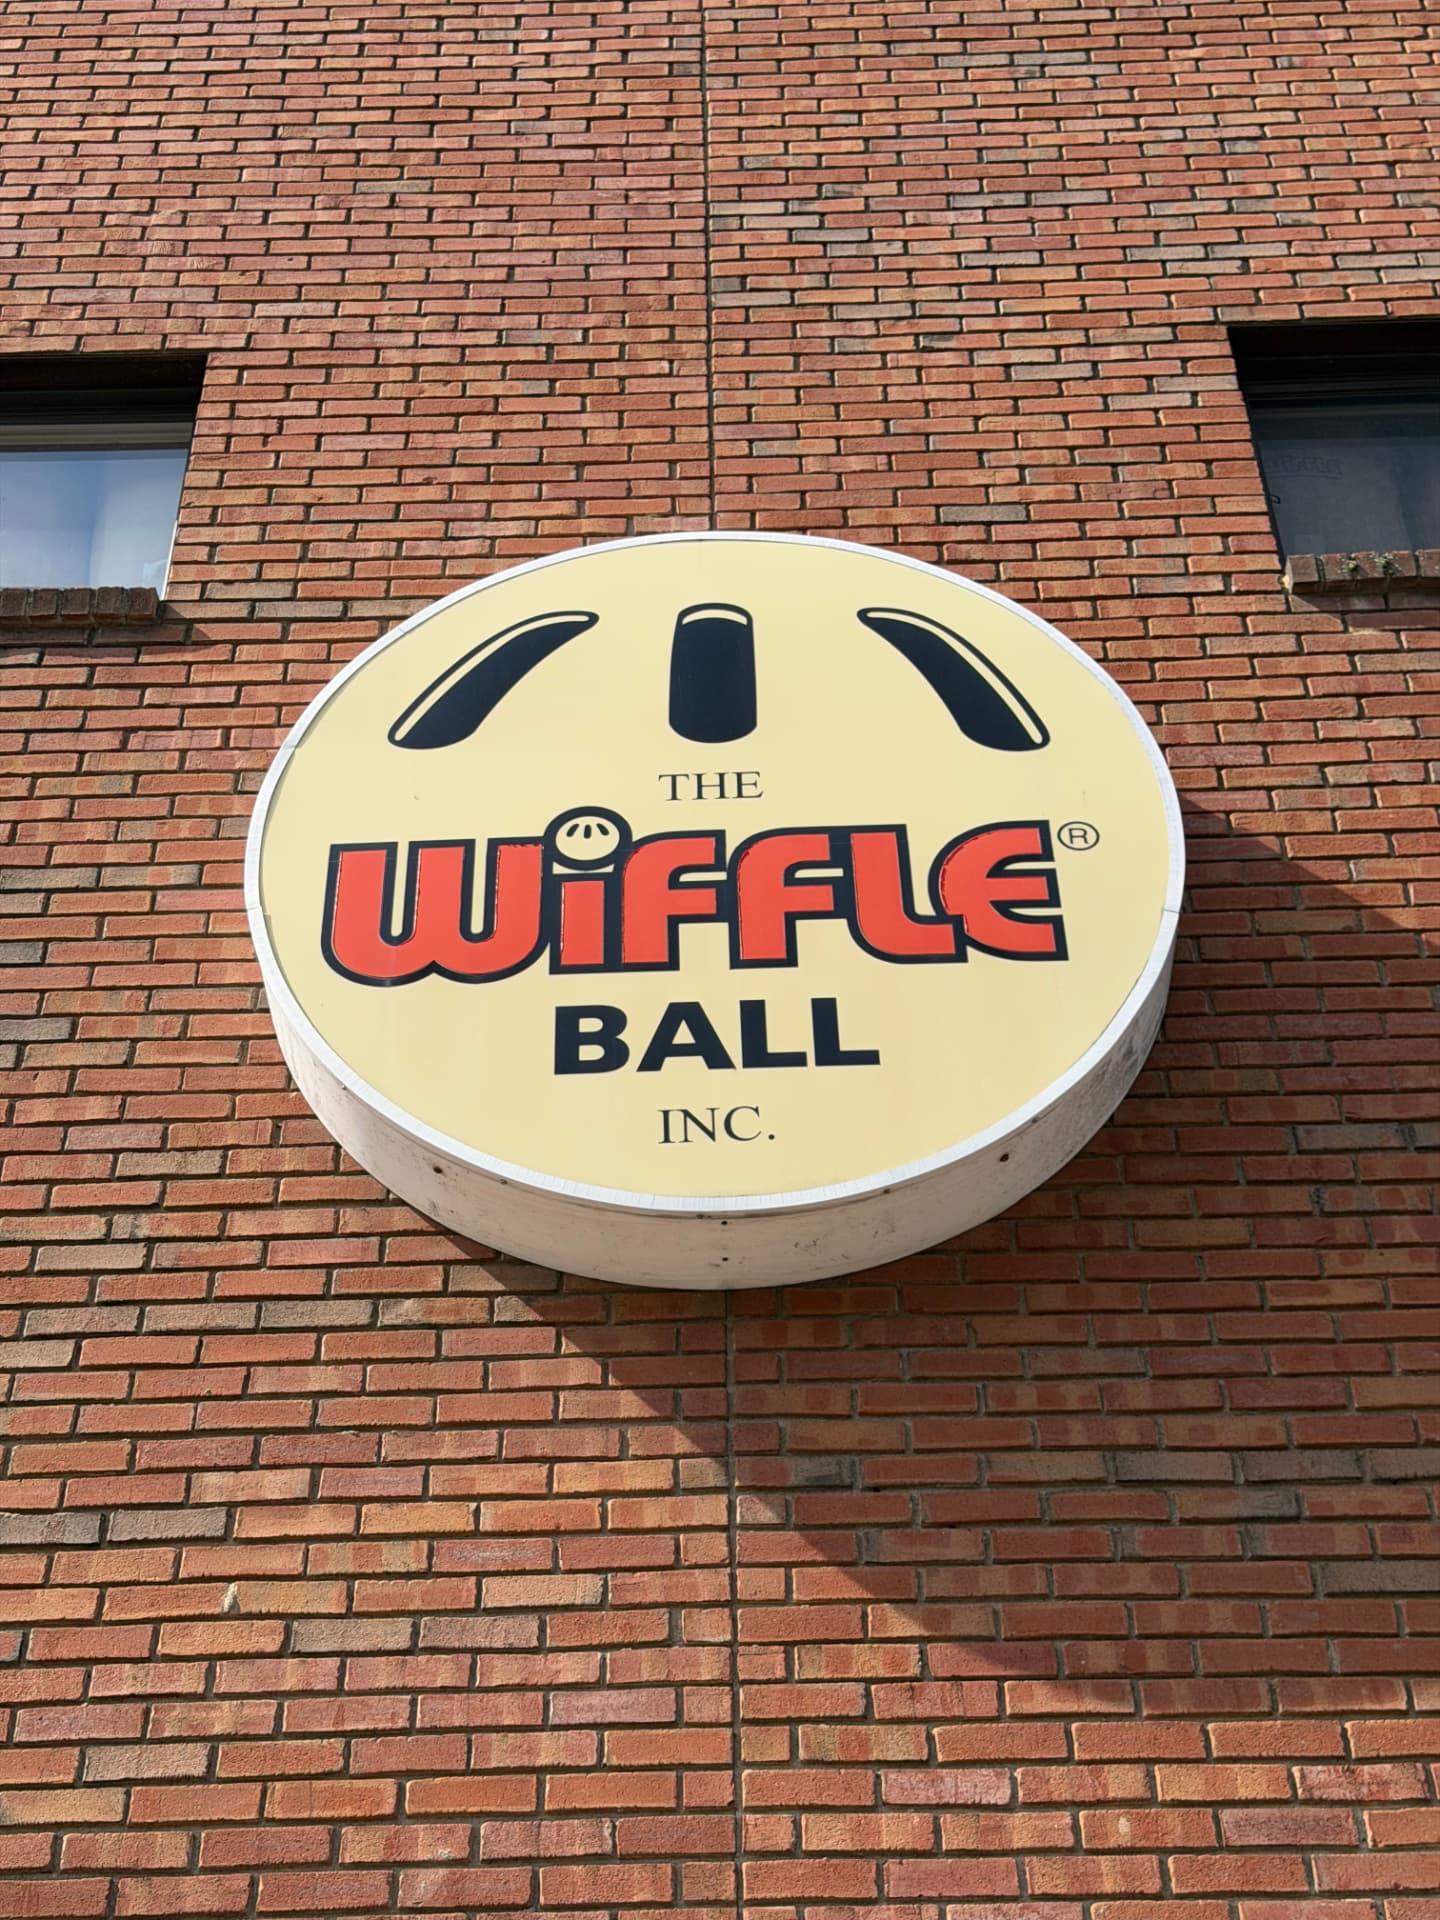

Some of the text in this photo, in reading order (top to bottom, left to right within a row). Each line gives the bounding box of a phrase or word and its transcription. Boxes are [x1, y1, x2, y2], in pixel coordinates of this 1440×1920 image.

[658, 771, 764, 801] THE
[554, 997, 881, 1075] BALL
[658, 1105, 776, 1145] INC.
